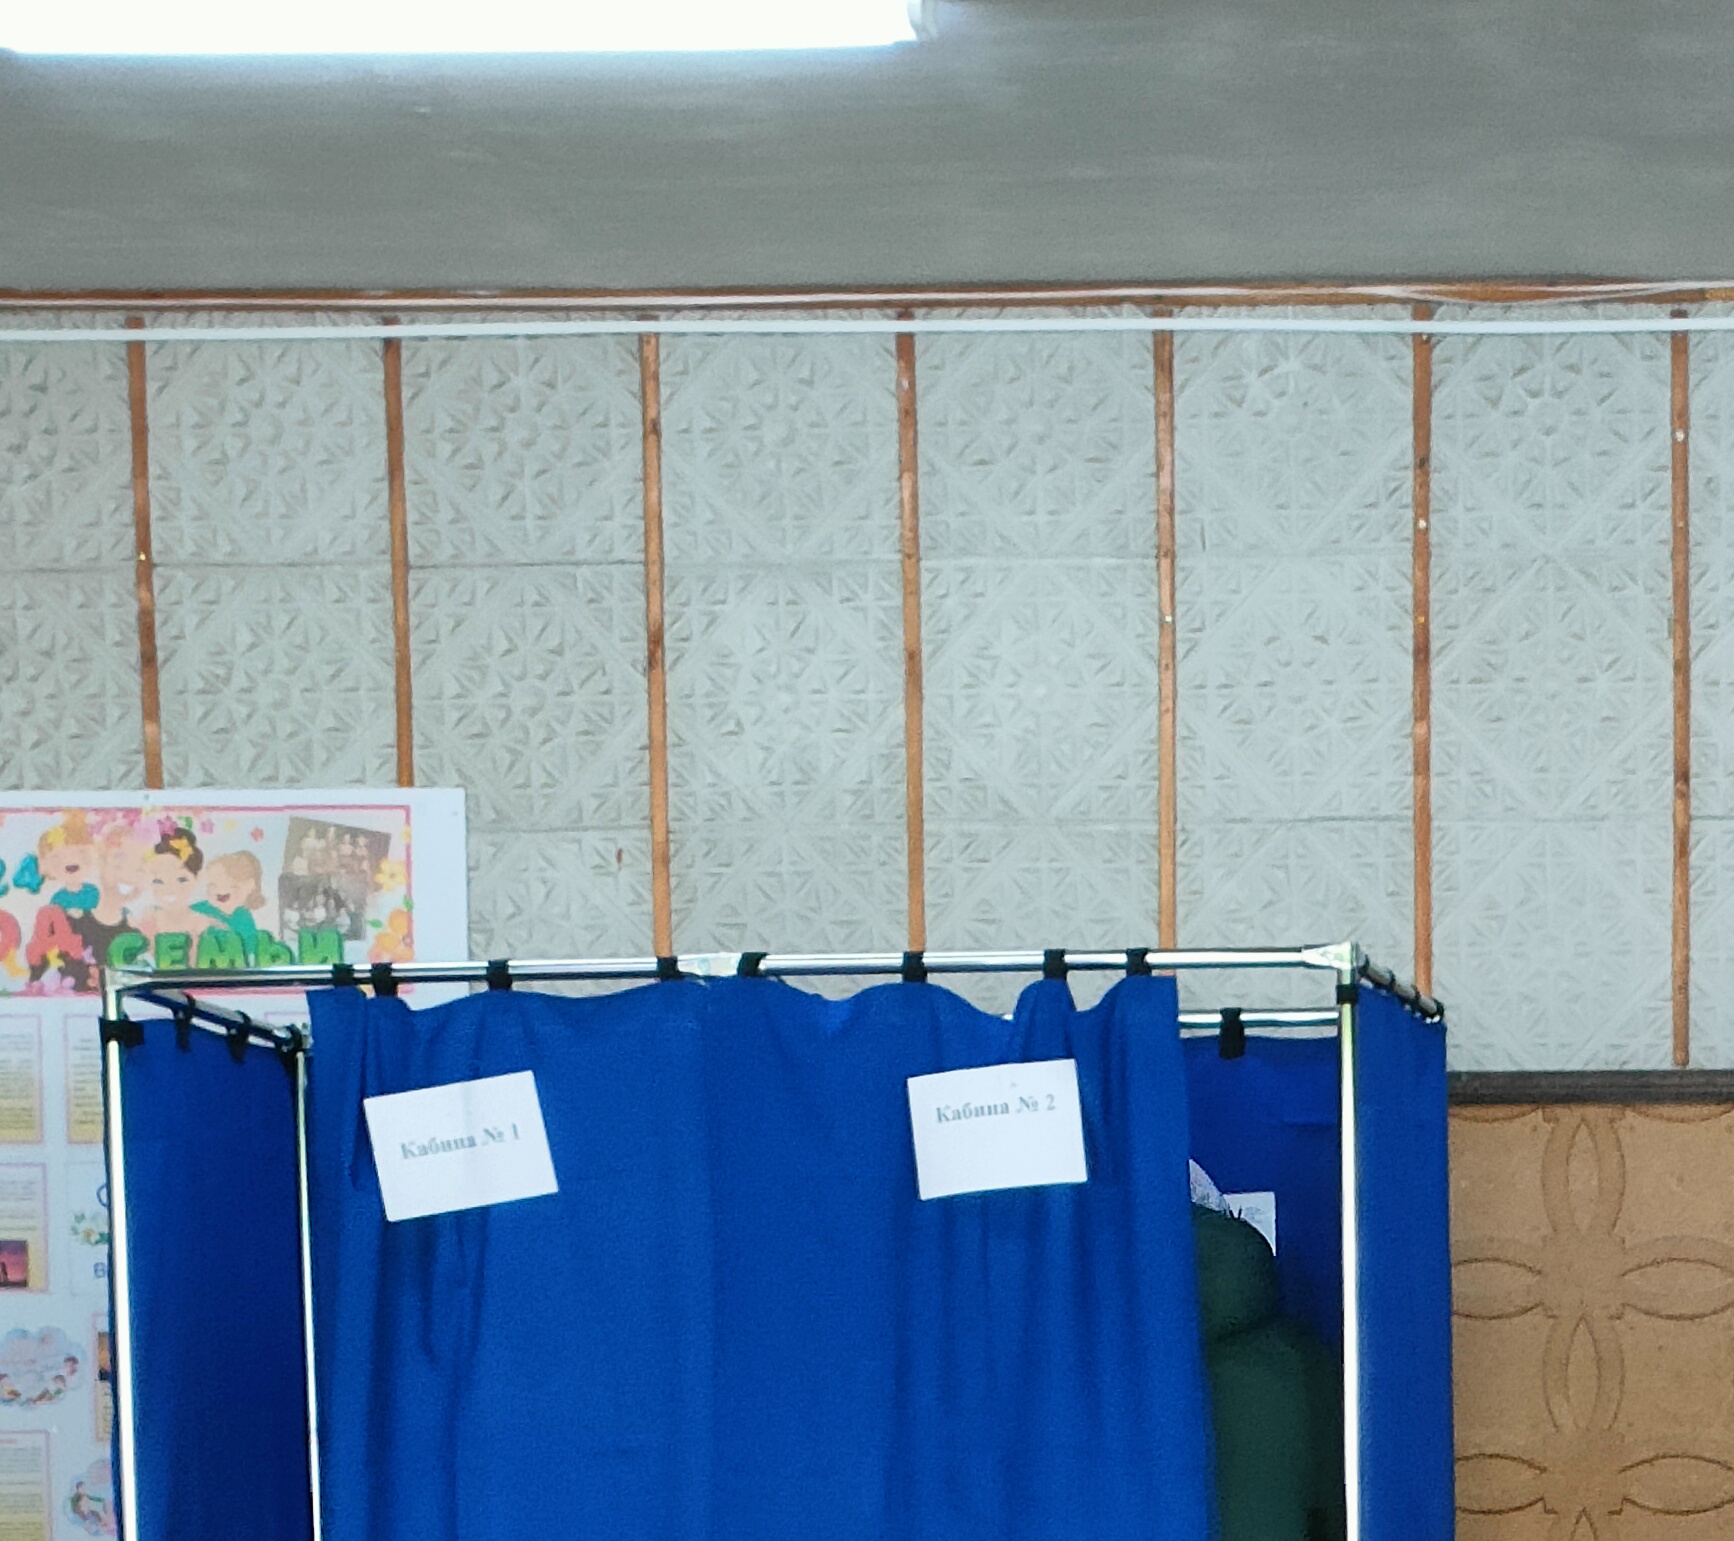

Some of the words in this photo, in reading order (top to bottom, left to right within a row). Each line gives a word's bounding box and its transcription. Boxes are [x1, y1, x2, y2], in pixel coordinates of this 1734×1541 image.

[107, 927, 344, 969] СЕМЬИ
[935, 1101, 1010, 1123] Кабина
[1015, 1095, 1039, 1114] №
[1046, 1093, 1056, 1111] 2
[399, 1135, 477, 1160] Кабина
[511, 1122, 520, 1141] 1
